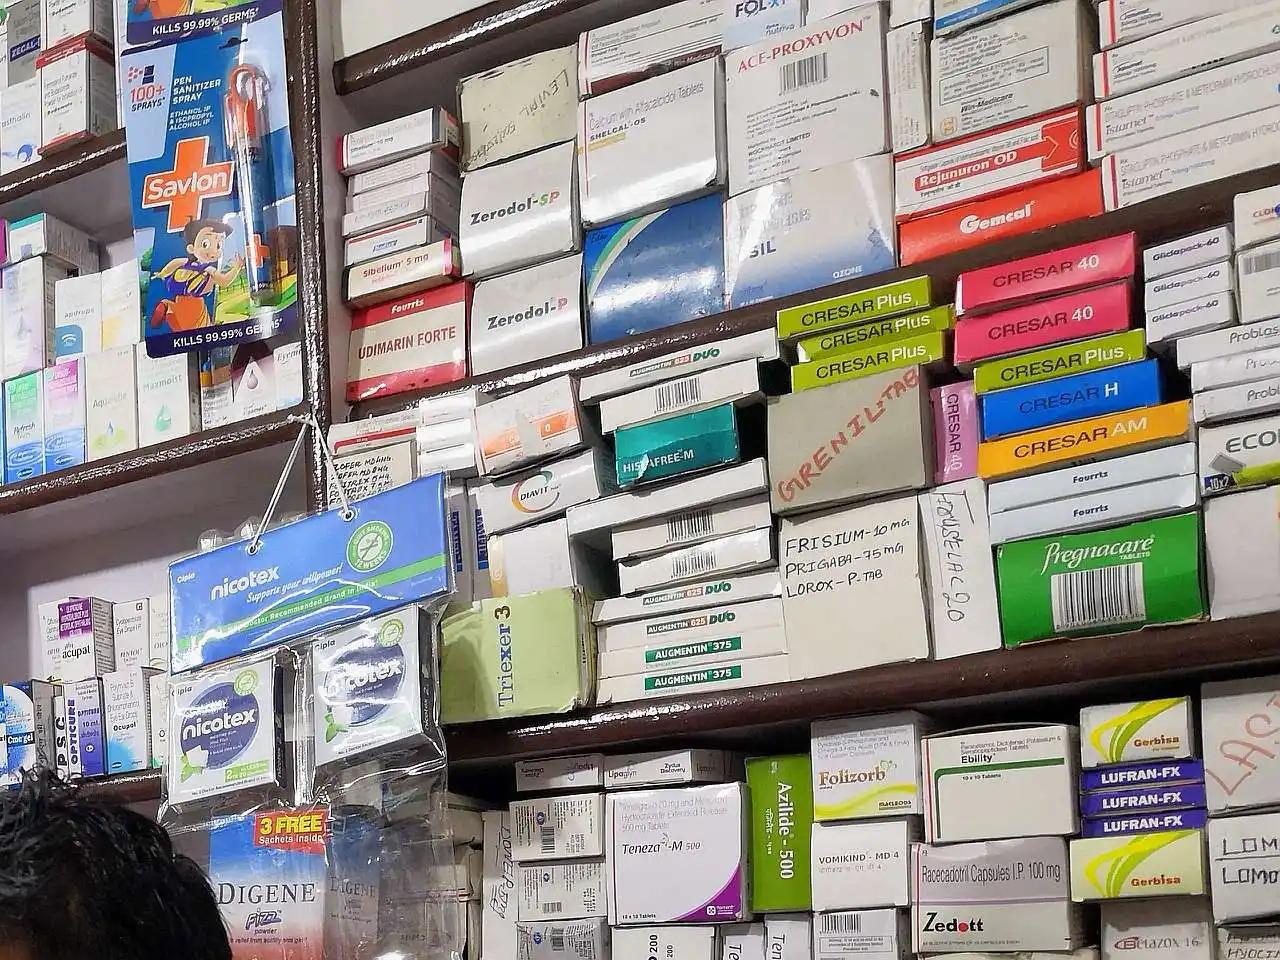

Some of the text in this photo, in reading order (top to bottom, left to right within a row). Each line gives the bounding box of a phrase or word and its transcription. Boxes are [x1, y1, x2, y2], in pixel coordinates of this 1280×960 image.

[152, 22, 181, 35] KILLS
[183, 14, 219, 31] 99.99%
[172, 78, 221, 95] SANITIZER
[173, 75, 192, 85] PEN
[130, 85, 165, 102] 100+
[172, 92, 203, 104] SPRAY
[919, 151, 1017, 188] Rejunuron OD
[146, 168, 228, 200] Savlon
[469, 190, 561, 226] Zerodol-SP
[959, 204, 1032, 234] Gemcal
[833, 264, 863, 280] OZONE
[992, 254, 1100, 289] CRESAR 40
[390, 298, 424, 314] Fourrts
[487, 296, 569, 330] Zerodol-P
[801, 291, 912, 327] CRESAR Plus
[819, 313, 930, 351] CRESAR Plus
[987, 306, 1094, 341] CRESAR 40
[173, 327, 243, 348] KILLS 99.99%
[357, 325, 456, 361] UDIMARIN FORTE
[630, 357, 673, 377] AUGMENTIN
[692, 347, 720, 363] DUO
[816, 344, 927, 379] CRESAR Plus
[1000, 345, 1124, 382] CRESAR Plus
[1018, 382, 1119, 414] CRESAR H
[945, 392, 961, 455] CRESAR
[1014, 417, 1149, 459] CRESAR AM
[1072, 469, 1108, 484] Fourrts
[1072, 503, 1109, 518] Fourrts
[1043, 536, 1153, 575] Pregnacare
[211, 564, 281, 601] nicotex
[643, 589, 684, 605] AUGMENTIN
[704, 581, 732, 596] DUO
[647, 620, 690, 635] AUGMENTIN
[708, 611, 735, 626] DUO
[495, 605, 514, 707] Triexer 3
[654, 639, 732, 661] AUGMENTIN 375
[654, 667, 732, 688] AUGMENTIN 375
[182, 708, 256, 742] nicotex
[1134, 735, 1180, 747] Gerbisa
[961, 753, 993, 764] Ebility
[1101, 765, 1180, 784] LUFRAN-FX
[1102, 791, 1182, 809] LUFRAN-FX
[260, 816, 324, 834] 3 FREE
[778, 782, 794, 879] Azilide 500
[1103, 816, 1183, 832] LUFRAN-FX
[258, 834, 293, 845] Sachets
[686, 842, 701, 850] 500
[875, 852, 891, 862] MD
[892, 851, 899, 861] 4
[922, 865, 969, 884] Racecadotril
[971, 865, 1009, 883] Capsules
[1028, 863, 1045, 880] 100
[1047, 866, 1061, 883] mg
[1131, 874, 1181, 887] Gerbisa
[219, 881, 316, 905] DIGENE
[648, 933, 659, 952] 200
